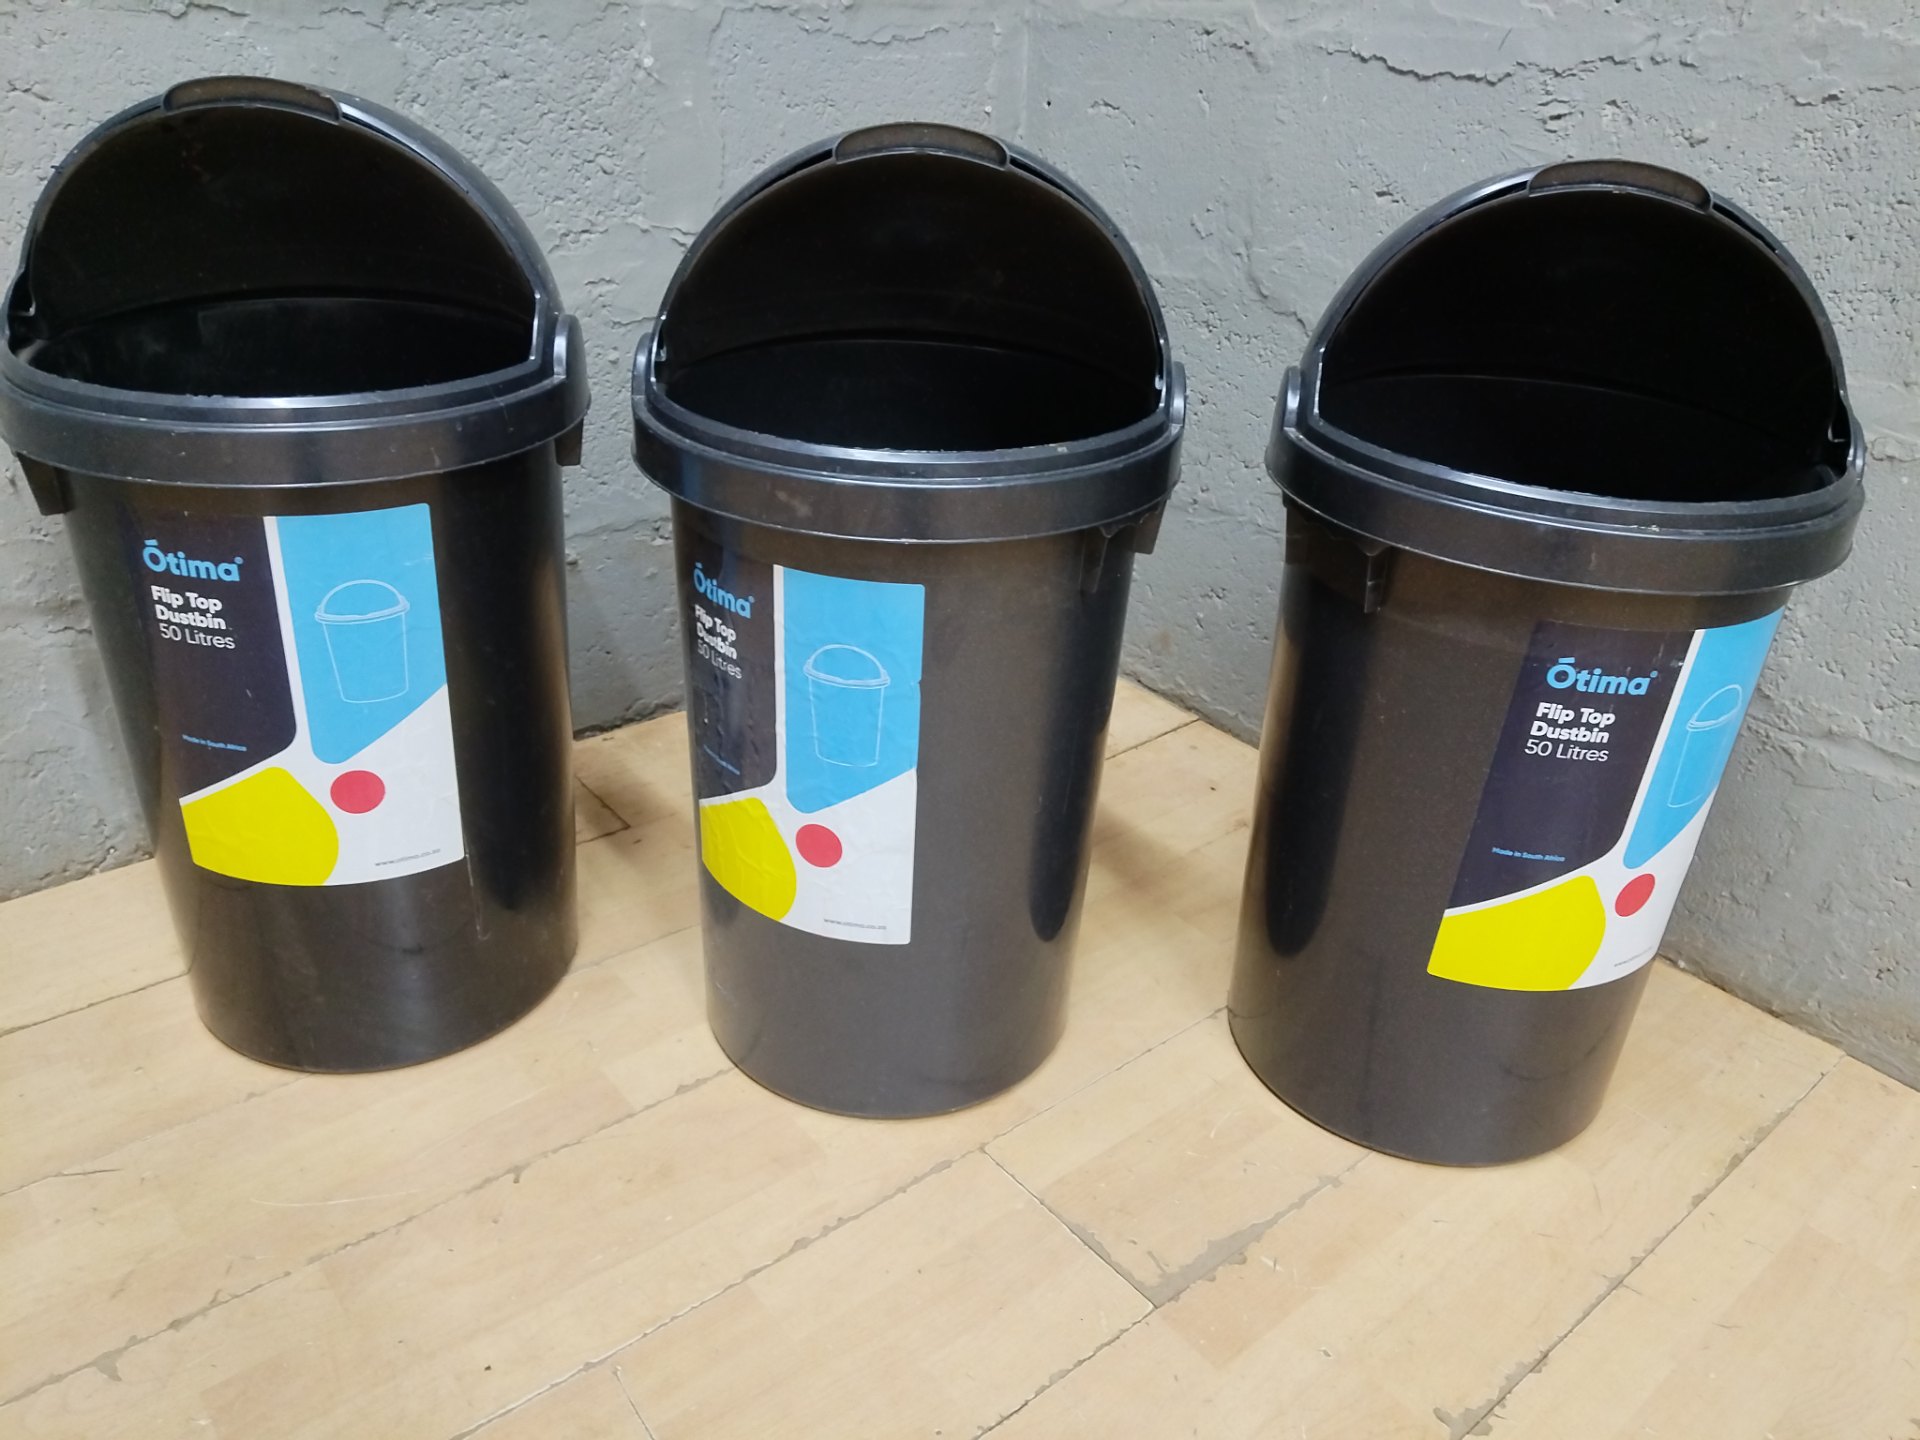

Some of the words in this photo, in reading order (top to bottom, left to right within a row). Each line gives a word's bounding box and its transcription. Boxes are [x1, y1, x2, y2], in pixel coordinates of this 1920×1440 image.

[151, 585, 184, 608] Flip
[185, 592, 223, 613] Top
[155, 604, 226, 630] Dustbin
[714, 617, 737, 642] Top
[159, 622, 182, 641] 50
[185, 628, 236, 649] Litres
[711, 650, 742, 679] Litres
[1536, 702, 1575, 724] Flip
[1580, 707, 1616, 728] Top
[1530, 720, 1610, 743] Dustbin
[1524, 739, 1553, 756] 50
[1556, 743, 1609, 761] Litres
